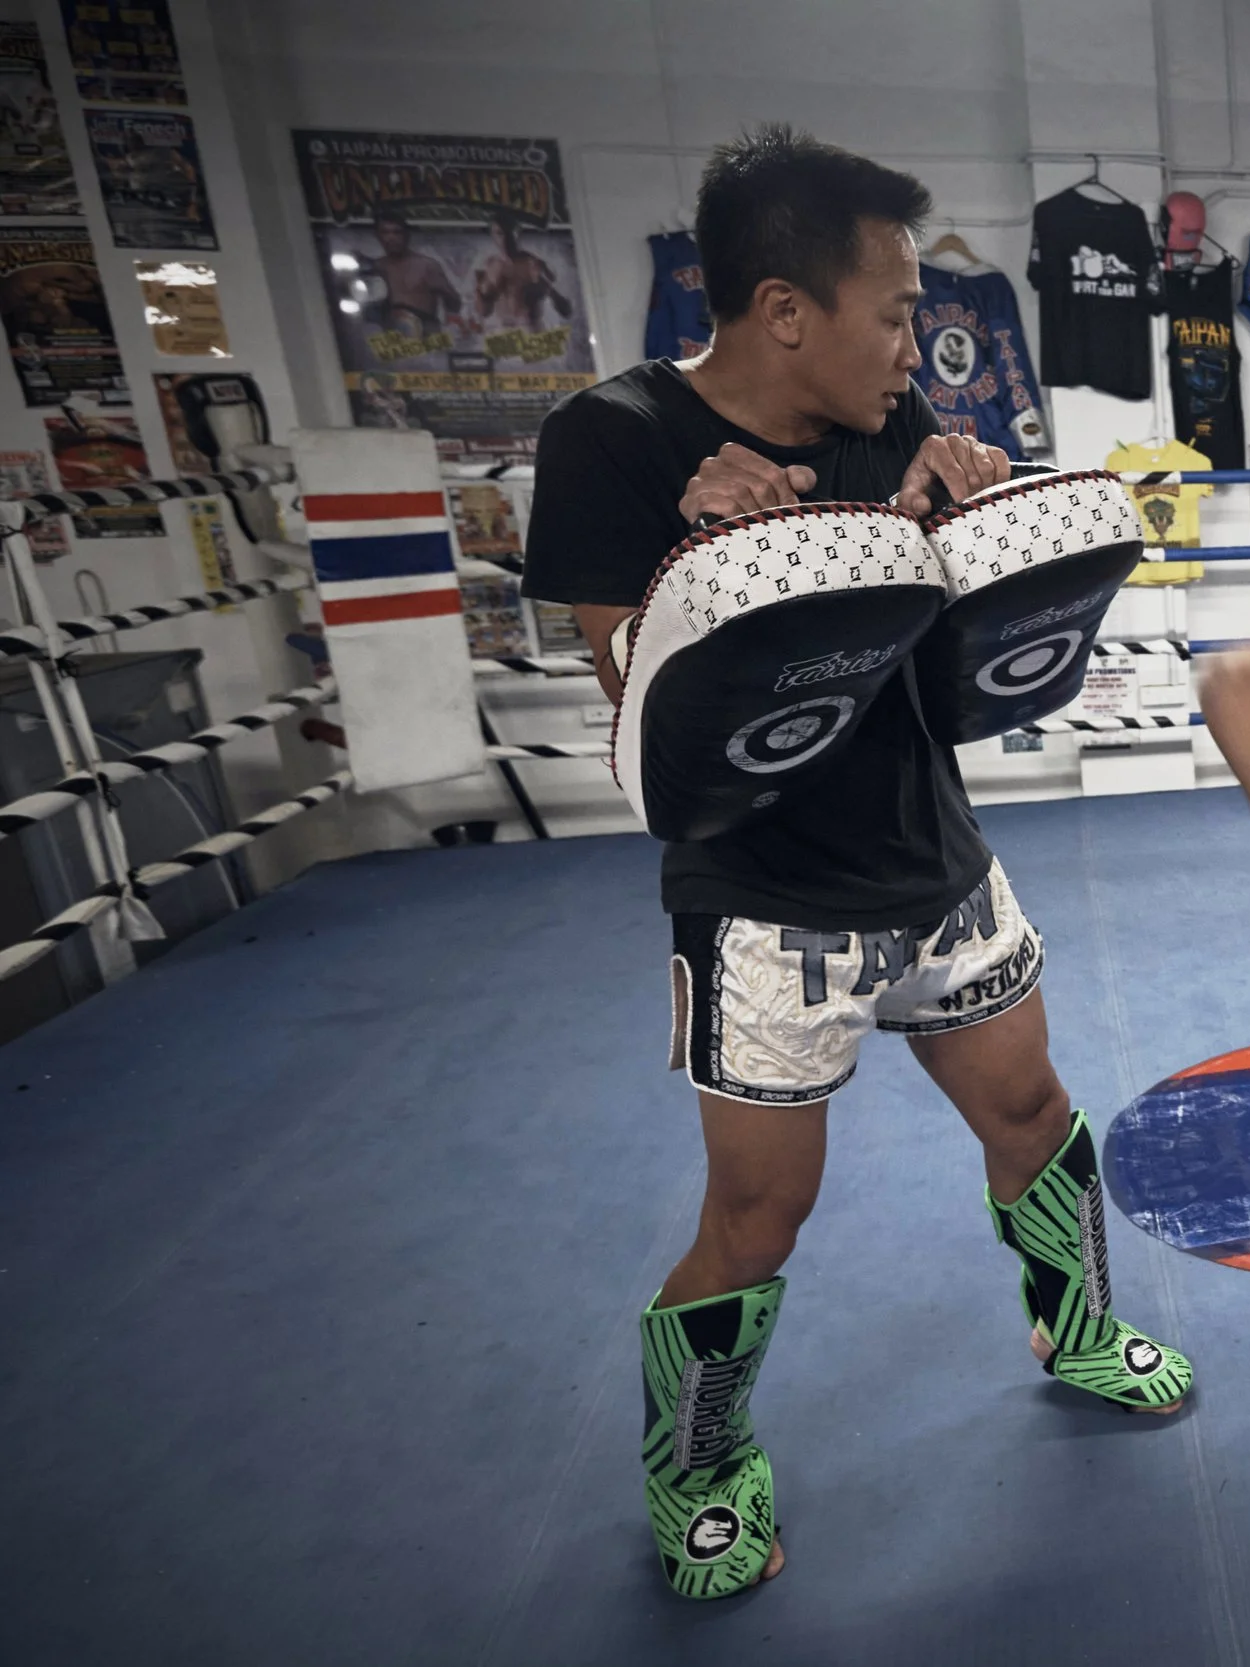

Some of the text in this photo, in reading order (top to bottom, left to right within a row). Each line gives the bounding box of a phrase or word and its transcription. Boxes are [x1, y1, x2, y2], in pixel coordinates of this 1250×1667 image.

[331, 140, 522, 162] TAIPAN PROMOTIONS
[320, 162, 551, 222] UNLEASHED
[918, 303, 991, 347] AIPAN
[1173, 317, 1232, 347] TAIPAN
[402, 374, 482, 389] SATURDAY
[518, 375, 549, 388] MAY
[1000, 591, 1103, 641] Fairtex
[773, 643, 897, 692] Fairtex
[779, 876, 999, 1008] TAAN
